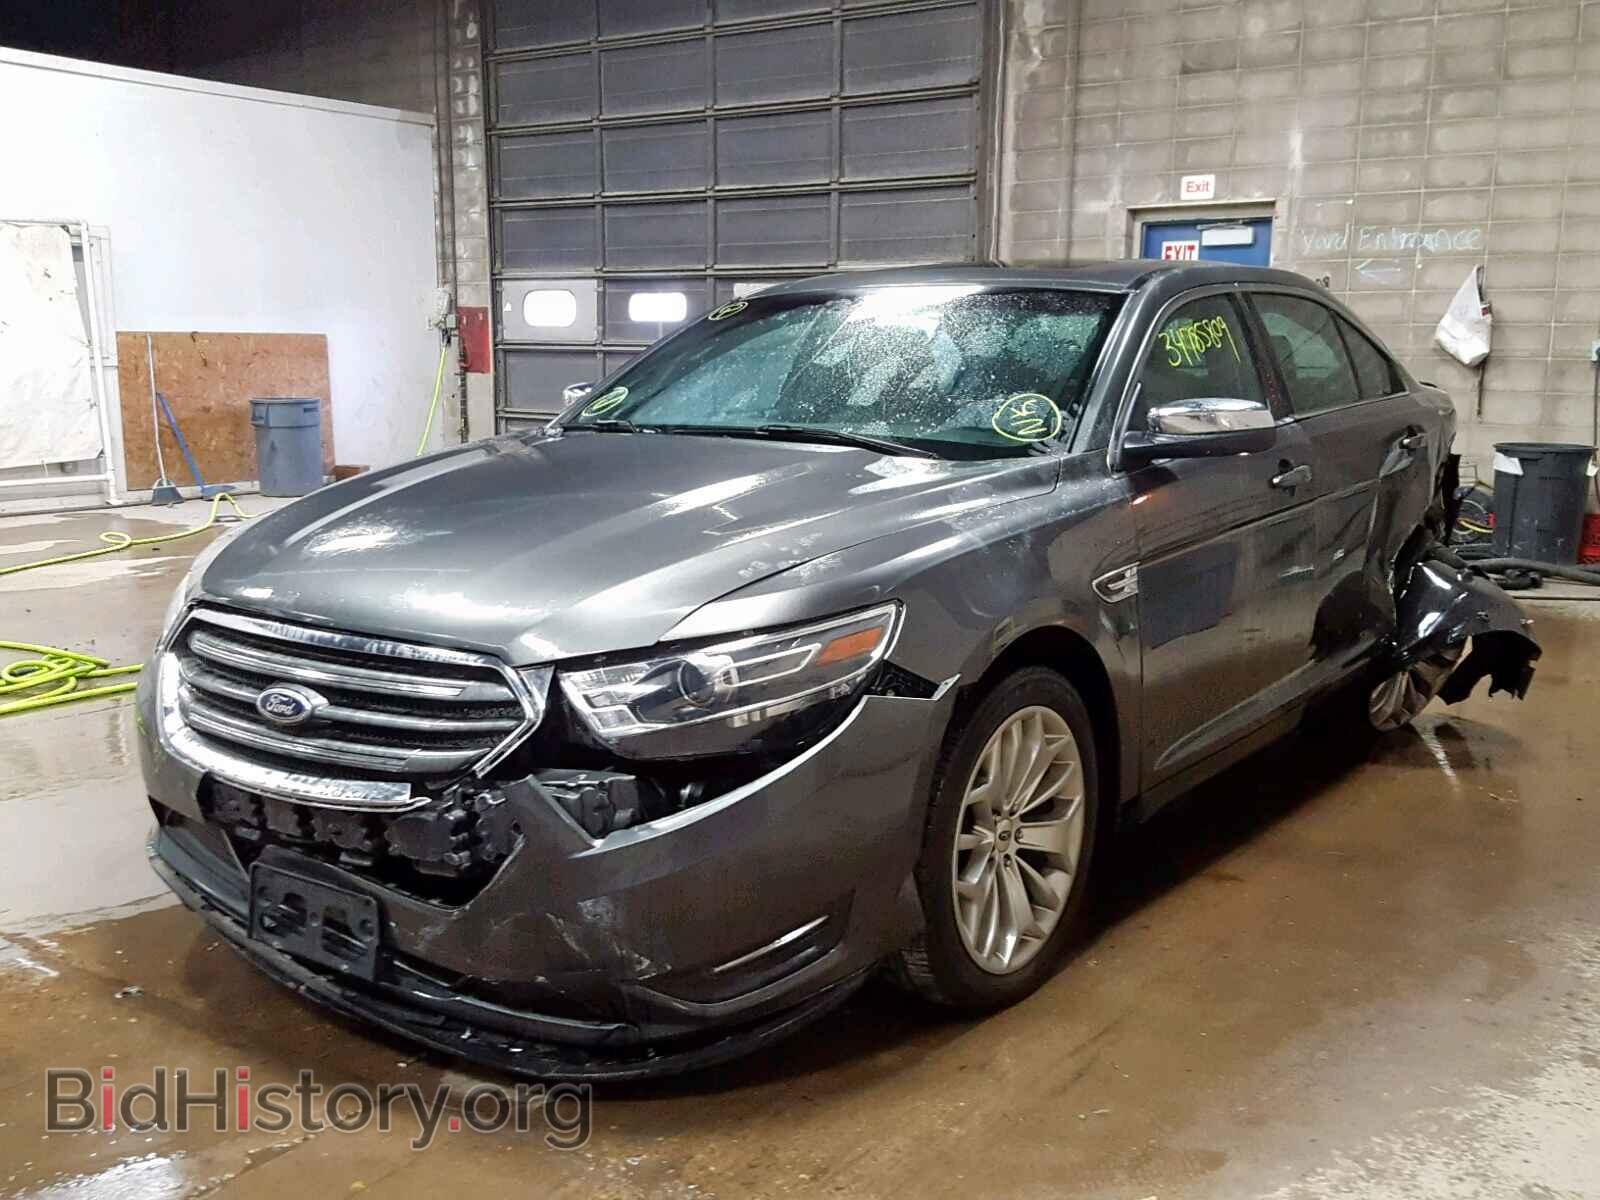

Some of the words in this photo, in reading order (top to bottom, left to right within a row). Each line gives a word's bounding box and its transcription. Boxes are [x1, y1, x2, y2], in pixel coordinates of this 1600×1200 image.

[1186, 181, 1210, 193] Exit
[1164, 244, 1196, 261] EXIT
[265, 693, 297, 716] Ford
